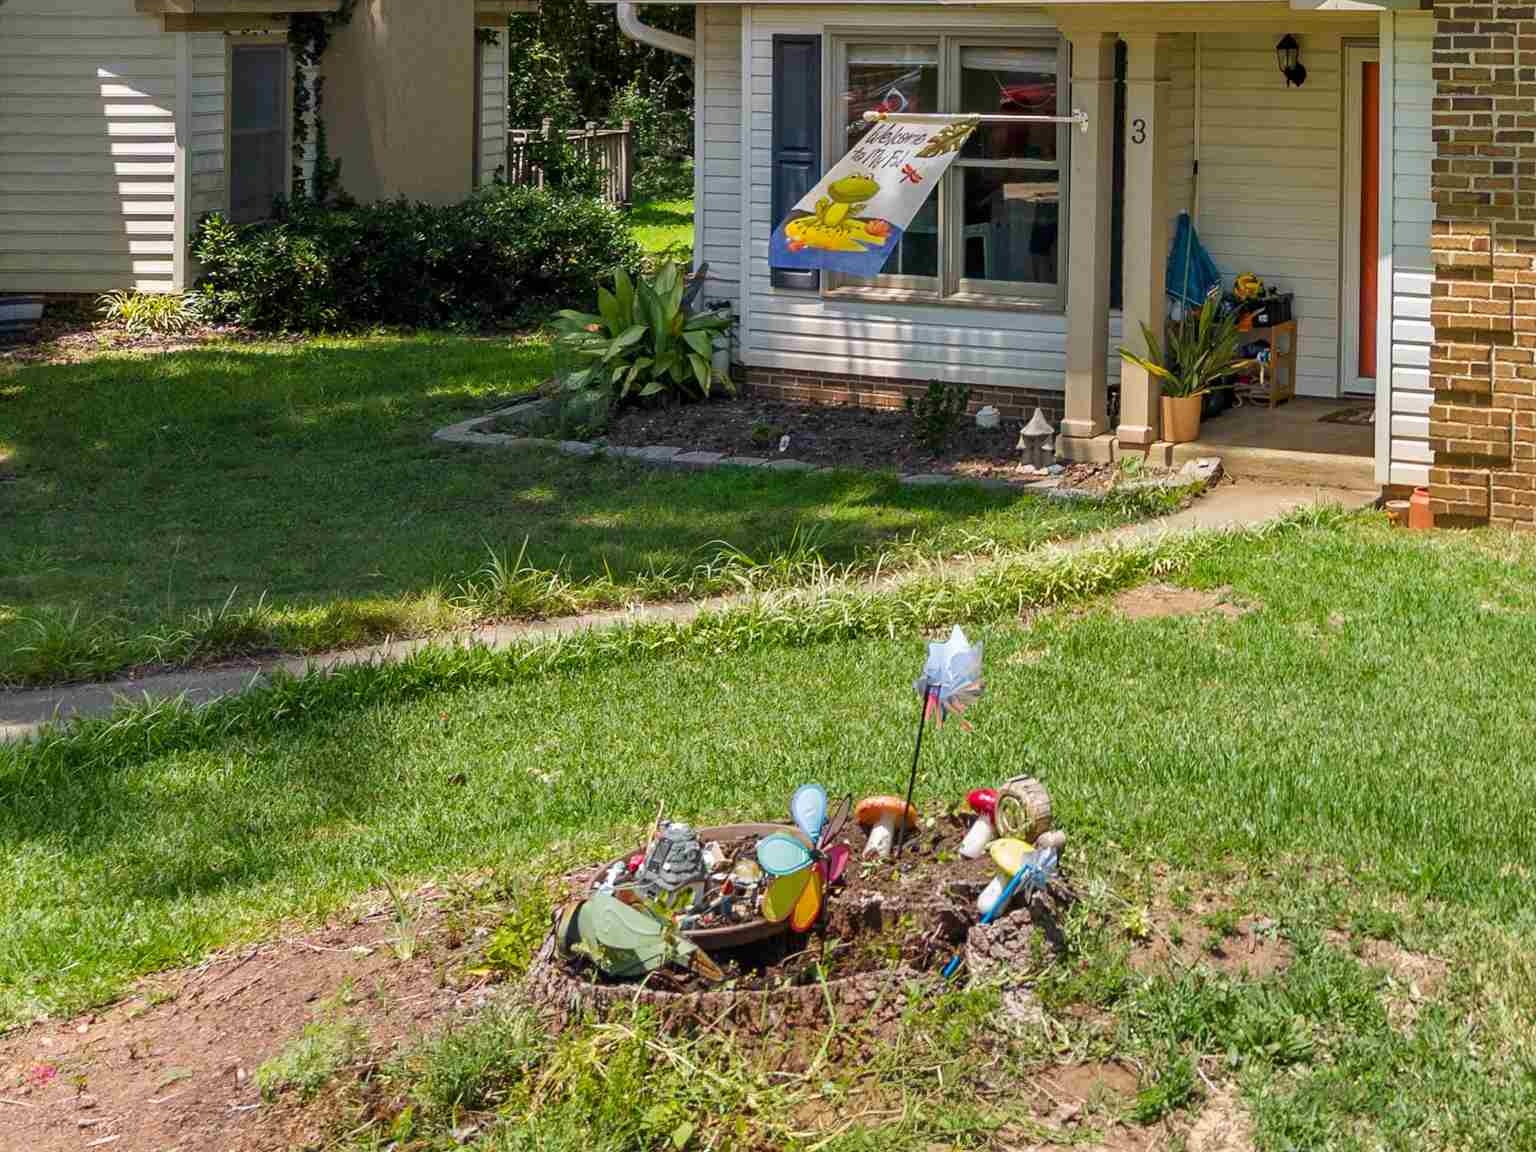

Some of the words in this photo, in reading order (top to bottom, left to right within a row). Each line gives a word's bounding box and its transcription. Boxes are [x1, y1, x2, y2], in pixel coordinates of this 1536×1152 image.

[865, 122, 928, 146] Welcome
[1132, 119, 1146, 144] 3
[851, 146, 866, 162] to
